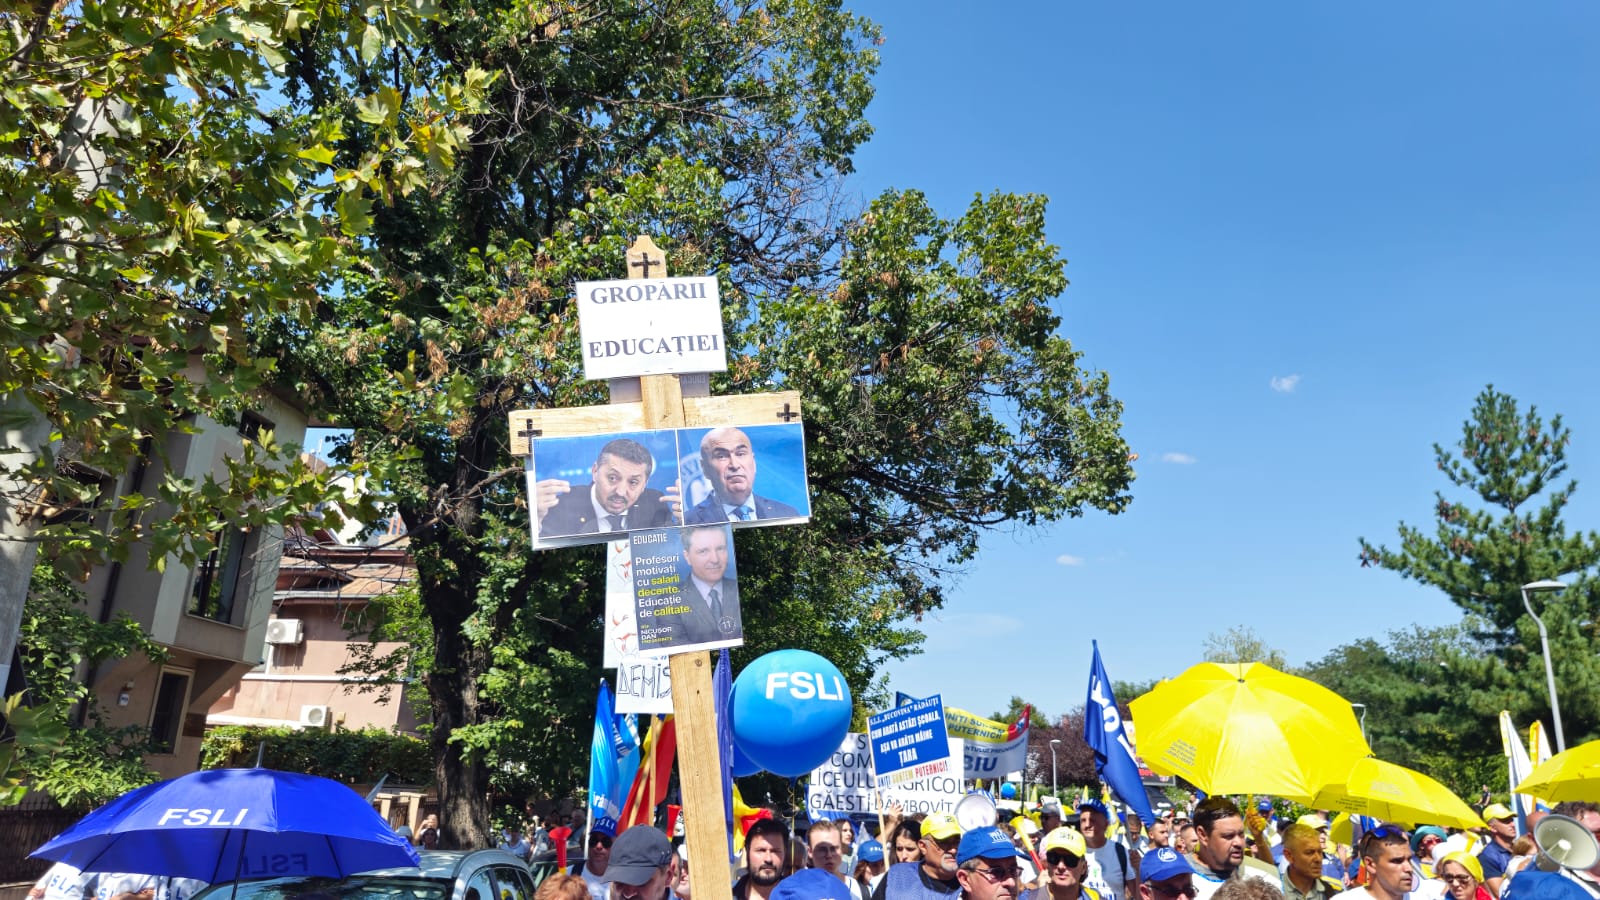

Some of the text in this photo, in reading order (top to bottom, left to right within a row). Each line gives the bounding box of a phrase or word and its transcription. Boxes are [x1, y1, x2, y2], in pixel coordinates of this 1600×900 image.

[635, 552, 680, 566] Profesori
[637, 574, 680, 587] cu salarii
[639, 608, 653, 618] de
[765, 671, 844, 701] FSLI
[915, 760, 948, 778] PUTERNICI!
[158, 808, 249, 826] FSLI
